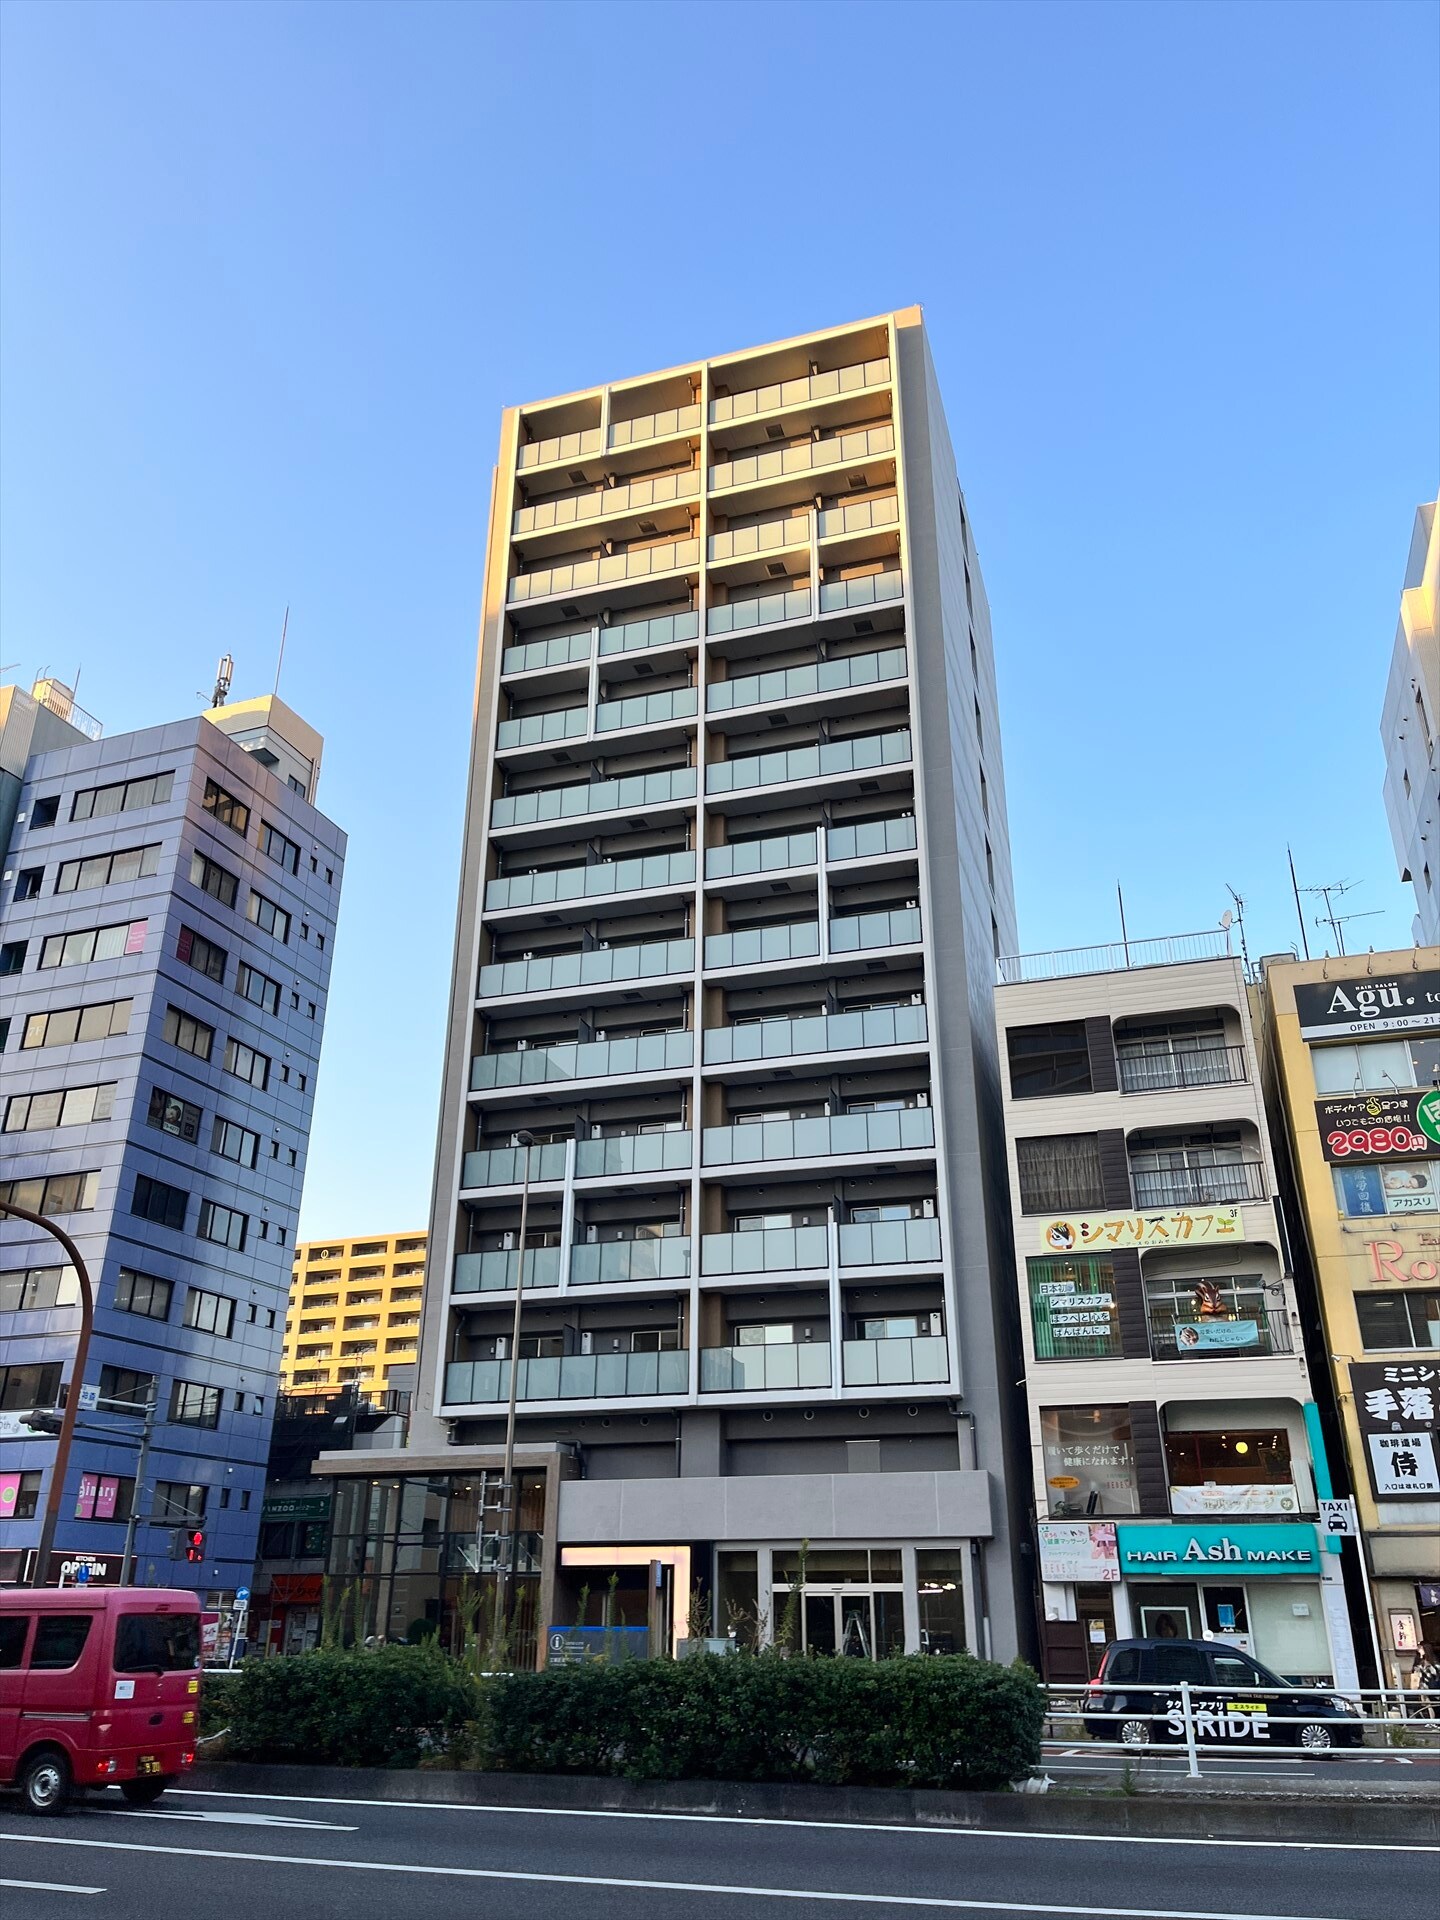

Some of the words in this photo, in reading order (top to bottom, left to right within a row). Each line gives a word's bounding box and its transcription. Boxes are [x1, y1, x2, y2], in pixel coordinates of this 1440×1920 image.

[1350, 1022, 1376, 1032] OPEN
[1324, 1102, 1366, 1115] ボディケア
[1393, 1197, 1432, 1208] アカスリ
[1229, 1209, 1238, 1218] 3F
[1080, 1211, 1236, 1245] シマリスカフェ
[1362, 1240, 1440, 1283] Ro
[1050, 1297, 1111, 1307] シマリスカフェ
[1383, 1366, 1440, 1383] ミニシ
[1364, 1386, 1440, 1421] 手落
[1379, 1437, 1422, 1448] 珈琲道場
[1391, 1451, 1419, 1477] 侍
[1321, 1502, 1348, 1512] TAXI
[1126, 1551, 1178, 1562] HAIR
[1182, 1537, 1244, 1562] Ash
[1246, 1550, 1312, 1562] MAKE
[1102, 1568, 1118, 1580] 2F
[1166, 1700, 1224, 1710] タクーアプリ
